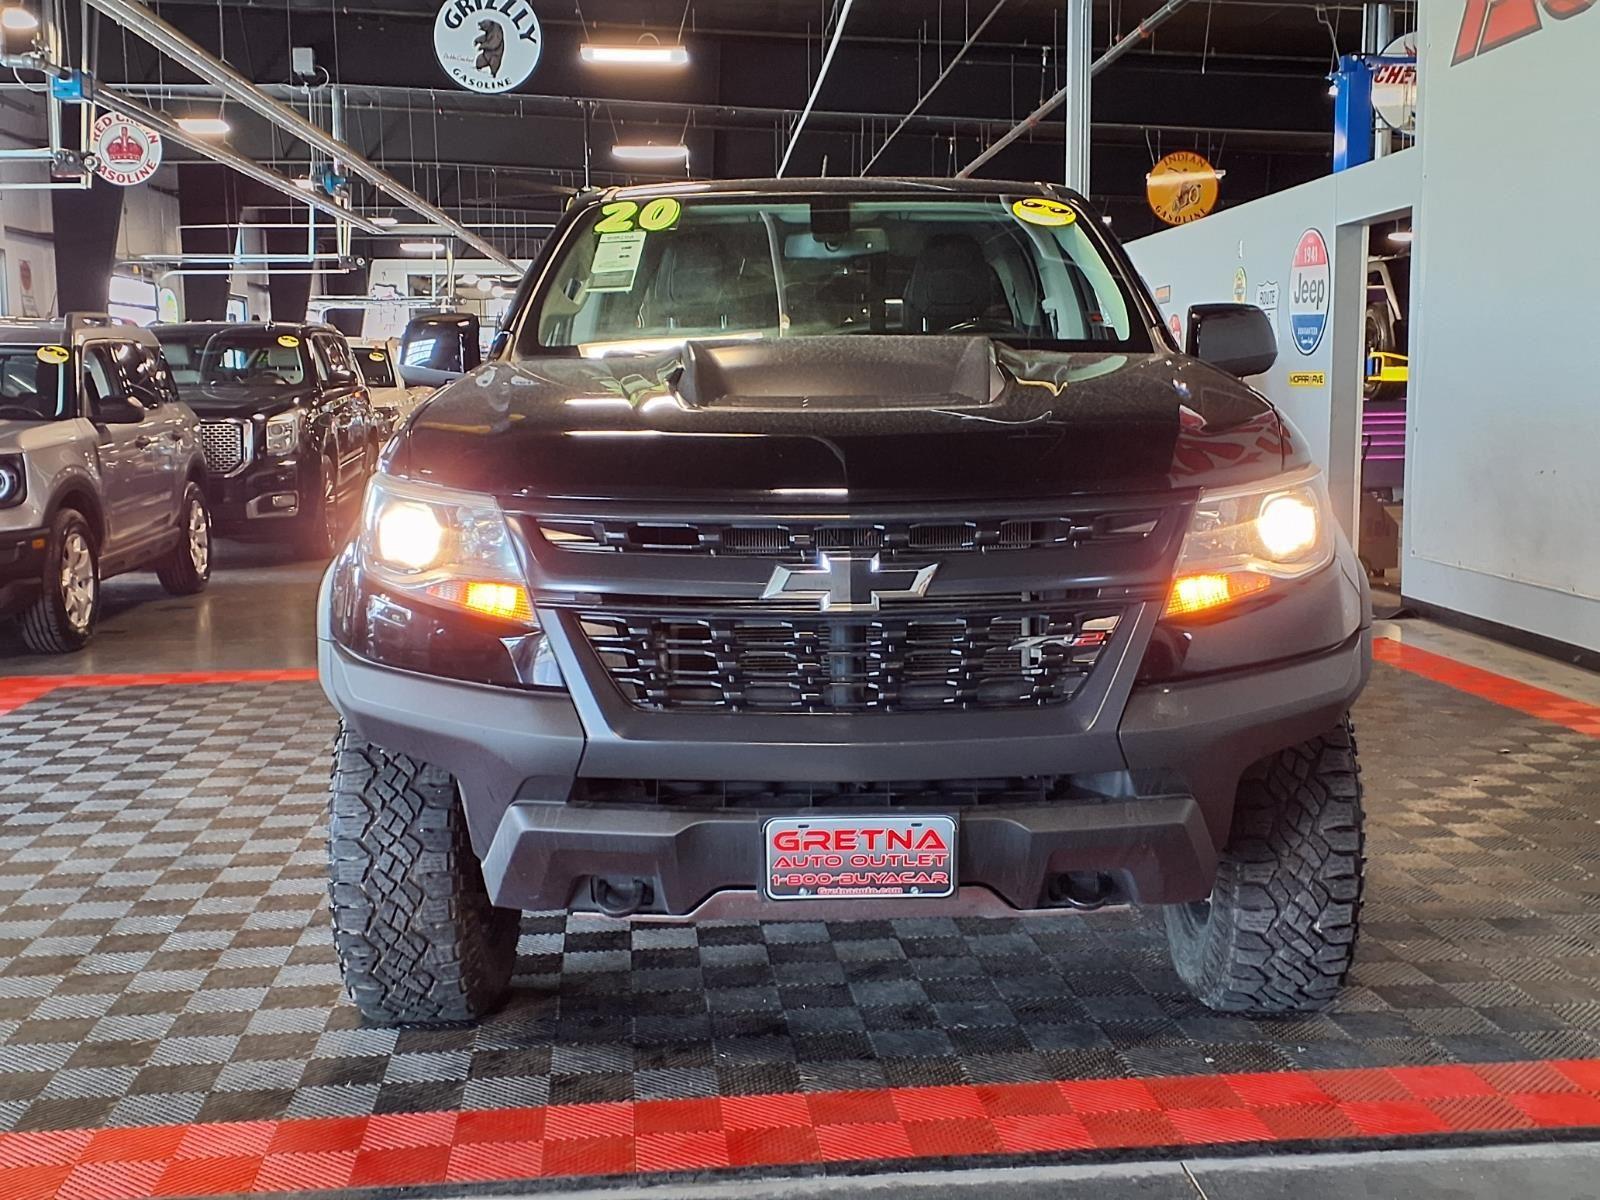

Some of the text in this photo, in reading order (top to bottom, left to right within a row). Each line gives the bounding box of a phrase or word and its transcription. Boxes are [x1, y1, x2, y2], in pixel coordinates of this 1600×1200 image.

[453, 68, 512, 90] GASOLINE
[1163, 153, 1207, 168] INDIAN
[593, 197, 681, 234] 20
[1304, 245, 1318, 264] 1941
[1259, 290, 1276, 305] ROUTE
[1293, 272, 1325, 310] Jeep
[773, 829, 948, 851] GRETNA
[773, 853, 949, 869] AUTO OUTLET
[772, 872, 949, 886] 1-800-BUYACAR
